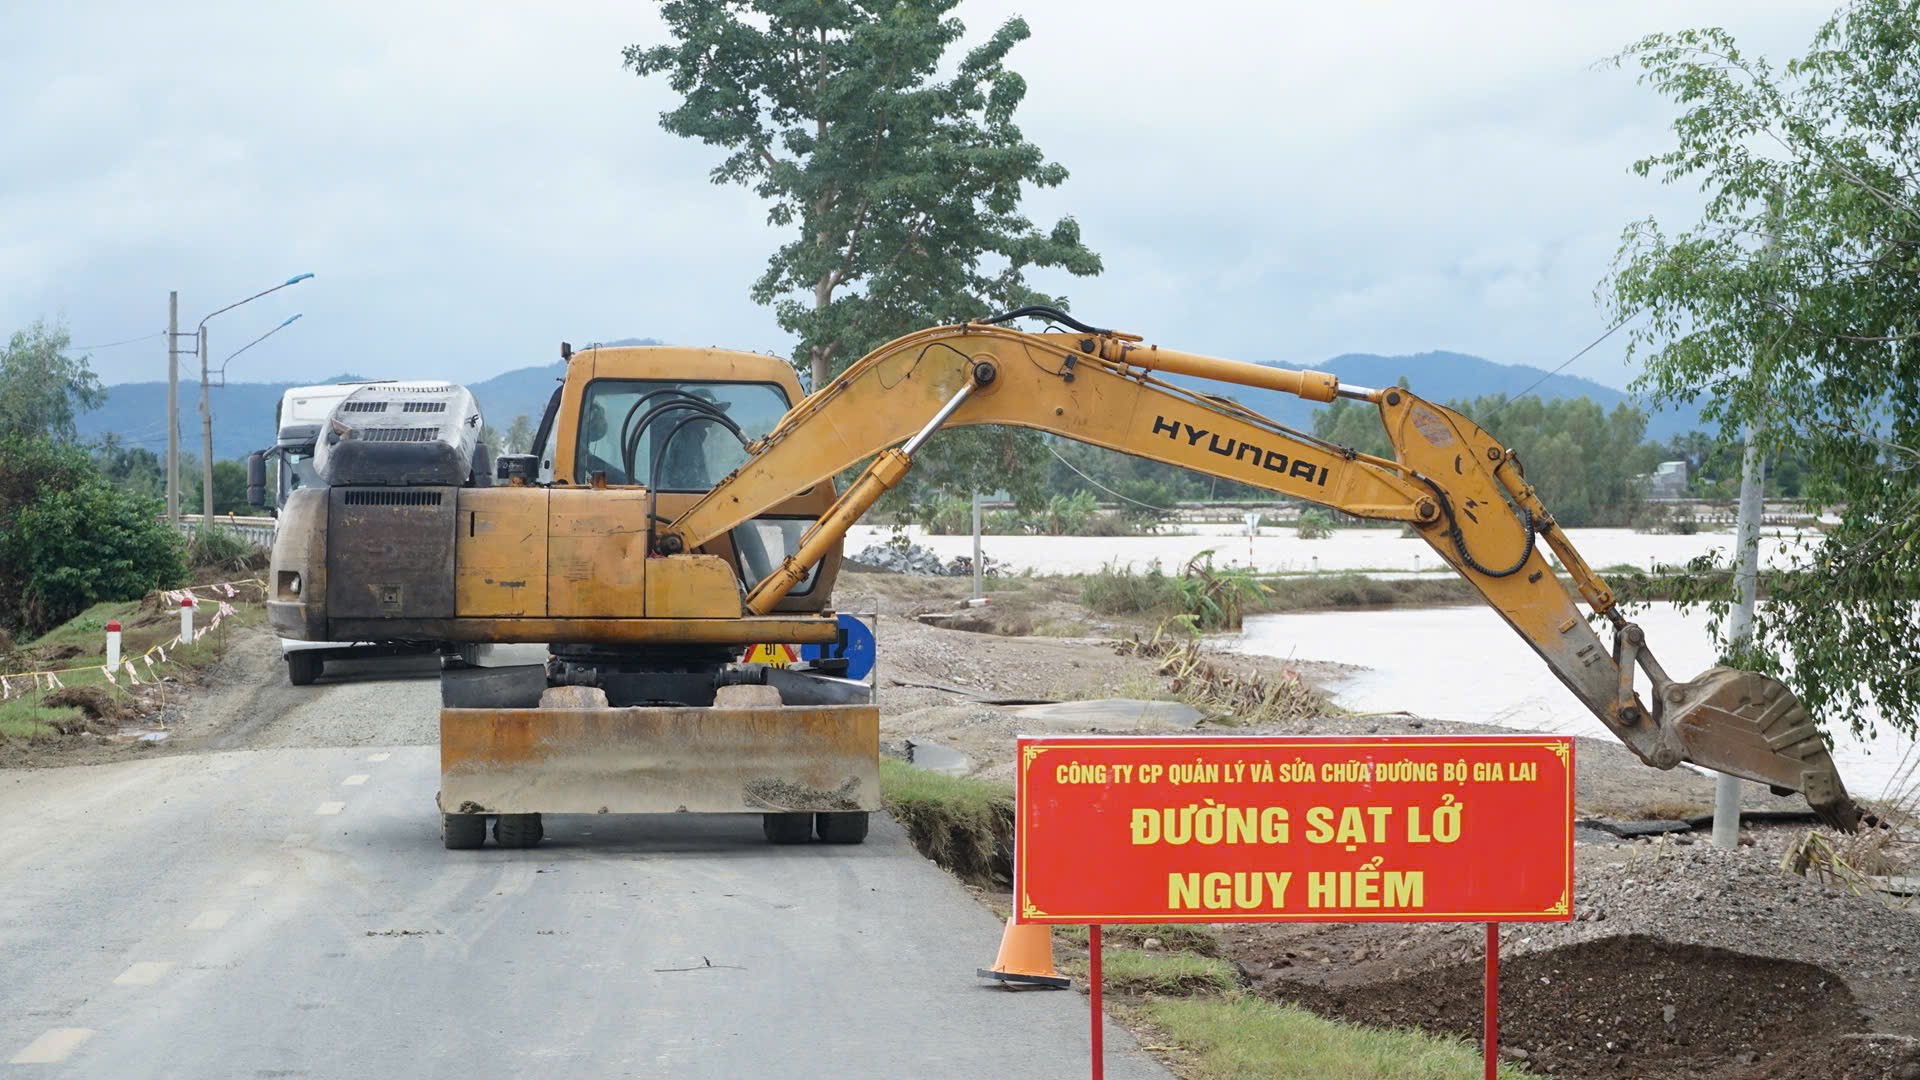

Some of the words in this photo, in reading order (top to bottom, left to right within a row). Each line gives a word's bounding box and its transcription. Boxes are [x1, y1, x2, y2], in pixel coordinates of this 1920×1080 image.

[1152, 415, 1329, 487] HYUNDAI
[1056, 761, 1107, 784] CÔNG
[1111, 764, 1134, 784] TY
[1138, 764, 1164, 784] CP
[1168, 758, 1219, 786] QUẢN
[1223, 760, 1246, 783] LÝ
[1250, 760, 1275, 783] VÀ
[1279, 757, 1317, 783] SỬA
[1321, 759, 1371, 783] CHỮA
[1375, 759, 1438, 783] ĐƯỜNG
[1443, 758, 1468, 786] BỘ
[1473, 762, 1505, 782] GIA
[1509, 762, 1537, 782] LAI
[1130, 799, 1289, 846] ĐƯỜNG
[1305, 806, 1393, 852] SẠT
[1408, 794, 1464, 844] LỞ
[1167, 871, 1293, 910] NGUY
[1307, 855, 1424, 909] HIỂM
